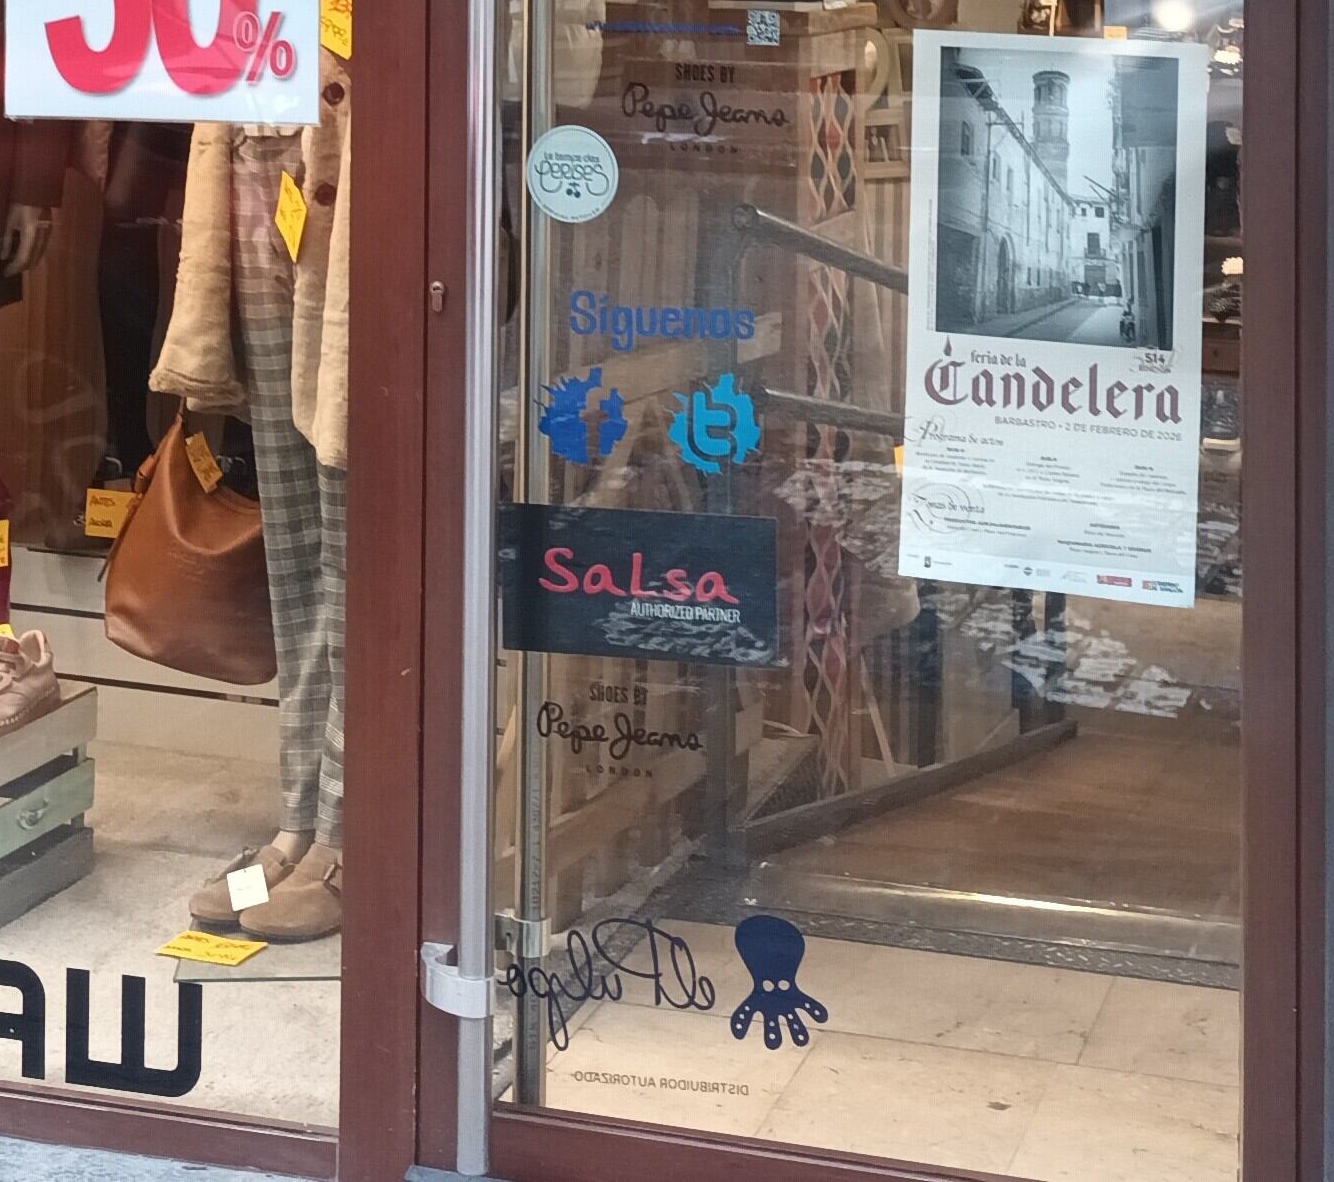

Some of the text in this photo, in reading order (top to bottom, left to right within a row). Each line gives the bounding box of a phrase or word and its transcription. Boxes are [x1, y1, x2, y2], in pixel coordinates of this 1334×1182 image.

[675, 63, 736, 83] SHOES BY
[621, 82, 792, 137] Pepe Jeans
[669, 144, 739, 154] LONDON
[570, 289, 757, 352] Síguenos
[970, 349, 1027, 368] feria de la
[924, 358, 1183, 424] Candelera
[994, 415, 1057, 430] BARBASTRO
[1064, 422, 1072, 432] 2
[1073, 423, 1087, 433] DE
[1089, 424, 1139, 438] FEBRERO
[1140, 429, 1154, 439] DE
[630, 601, 741, 624] AUTHORIZED PARTNER
[589, 684, 629, 703] SHOES
[536, 700, 704, 761] Pepe Jeans
[585, 765, 653, 779] LONDON
